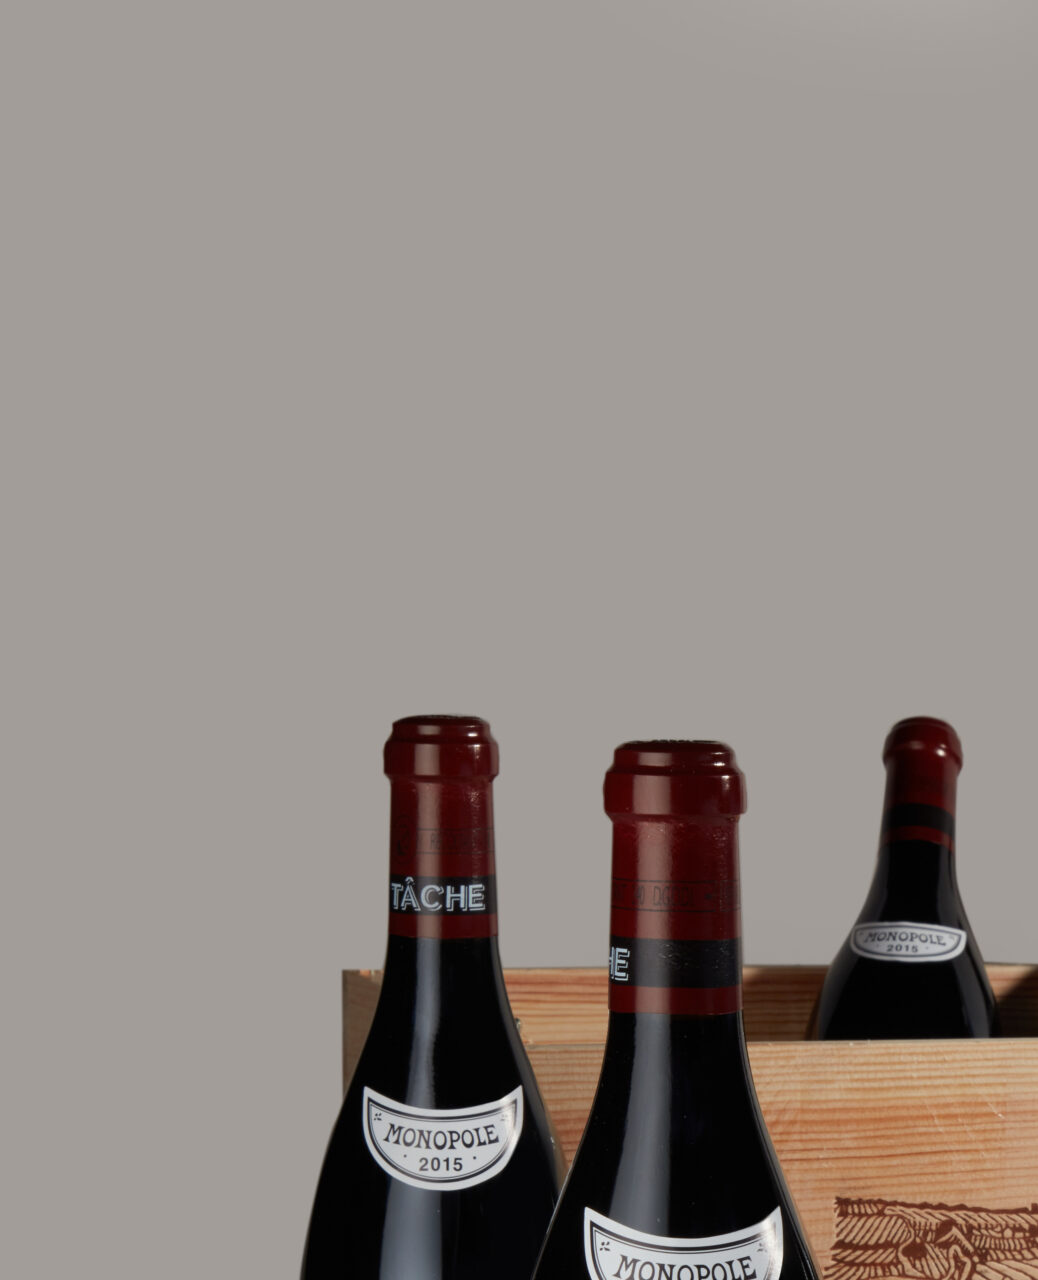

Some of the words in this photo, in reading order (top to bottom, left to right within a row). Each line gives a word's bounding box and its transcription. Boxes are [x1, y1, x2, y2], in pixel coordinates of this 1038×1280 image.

[391, 876, 486, 912] TÂCHE
[863, 930, 947, 947] MONOPOLE
[886, 944, 919, 953] 2015
[383, 1123, 500, 1150] MONOPOLE
[418, 1156, 463, 1173] 2015
